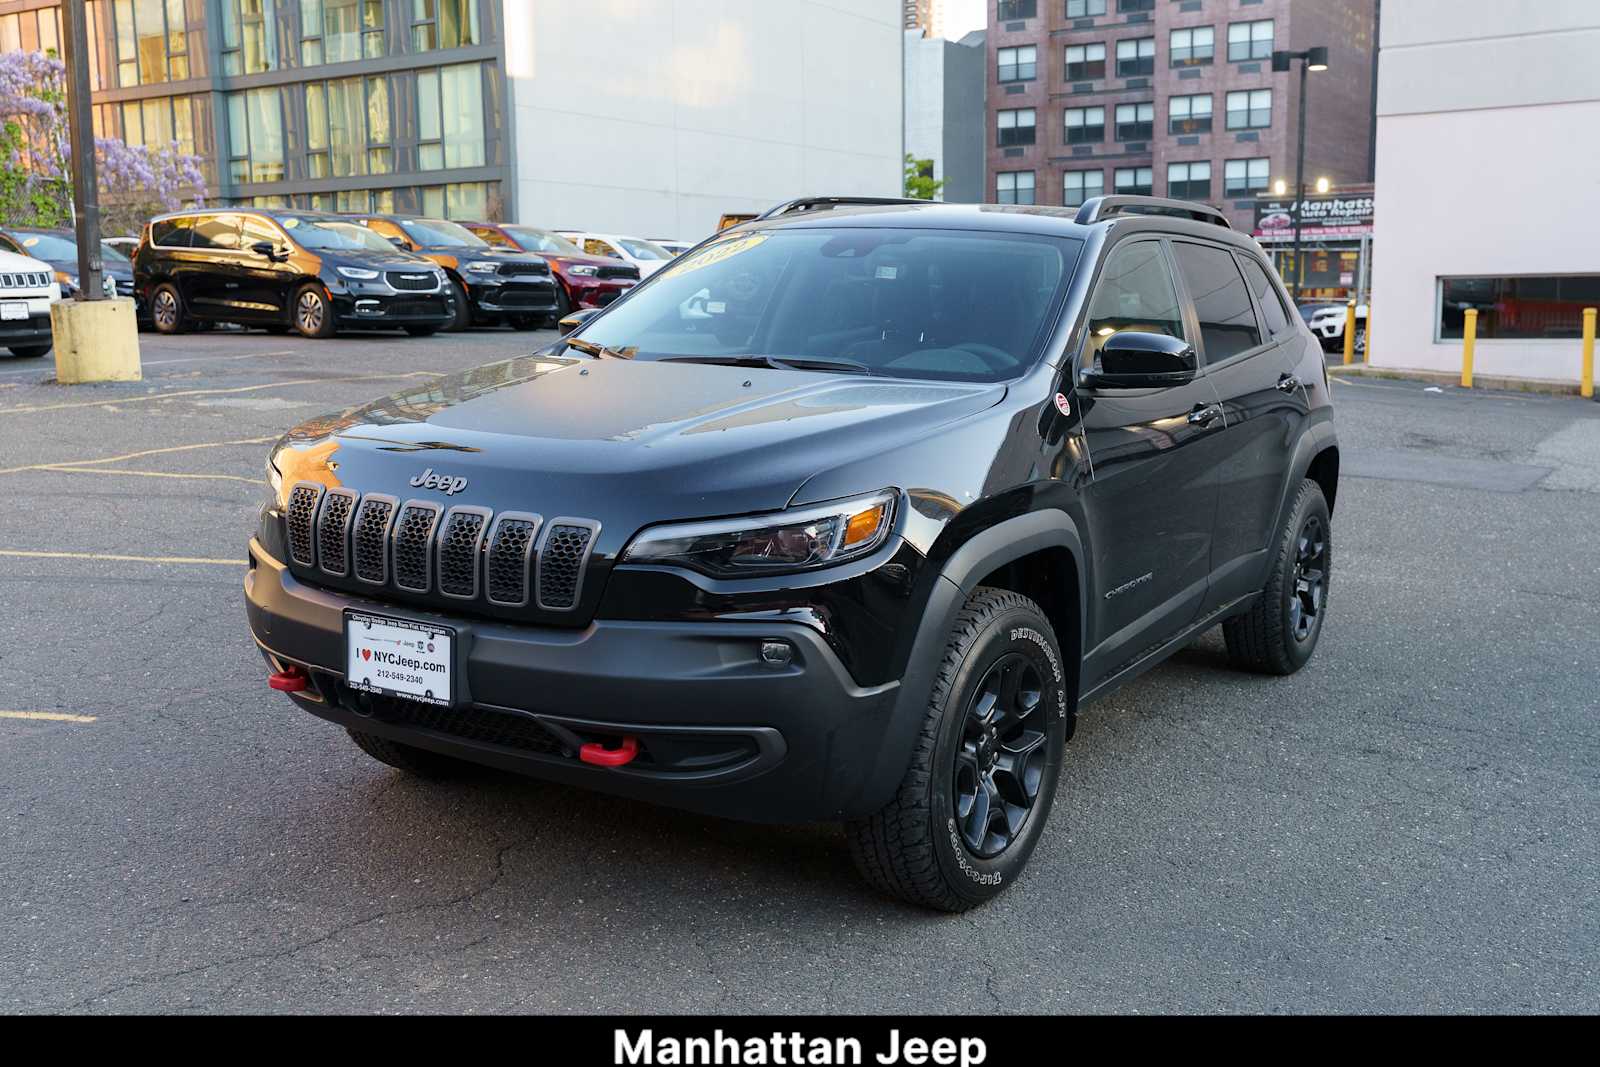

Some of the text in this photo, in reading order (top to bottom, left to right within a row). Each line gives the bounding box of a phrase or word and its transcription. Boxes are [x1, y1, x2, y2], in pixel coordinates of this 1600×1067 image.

[1290, 198, 1375, 212] Manhatt
[1330, 208, 1372, 217] Repair
[409, 468, 468, 496] Jeep
[356, 648, 446, 673] I NYCJeep.com
[377, 669, 424, 685] 212-549-2340
[396, 692, 449, 705] www.nycjeep.com
